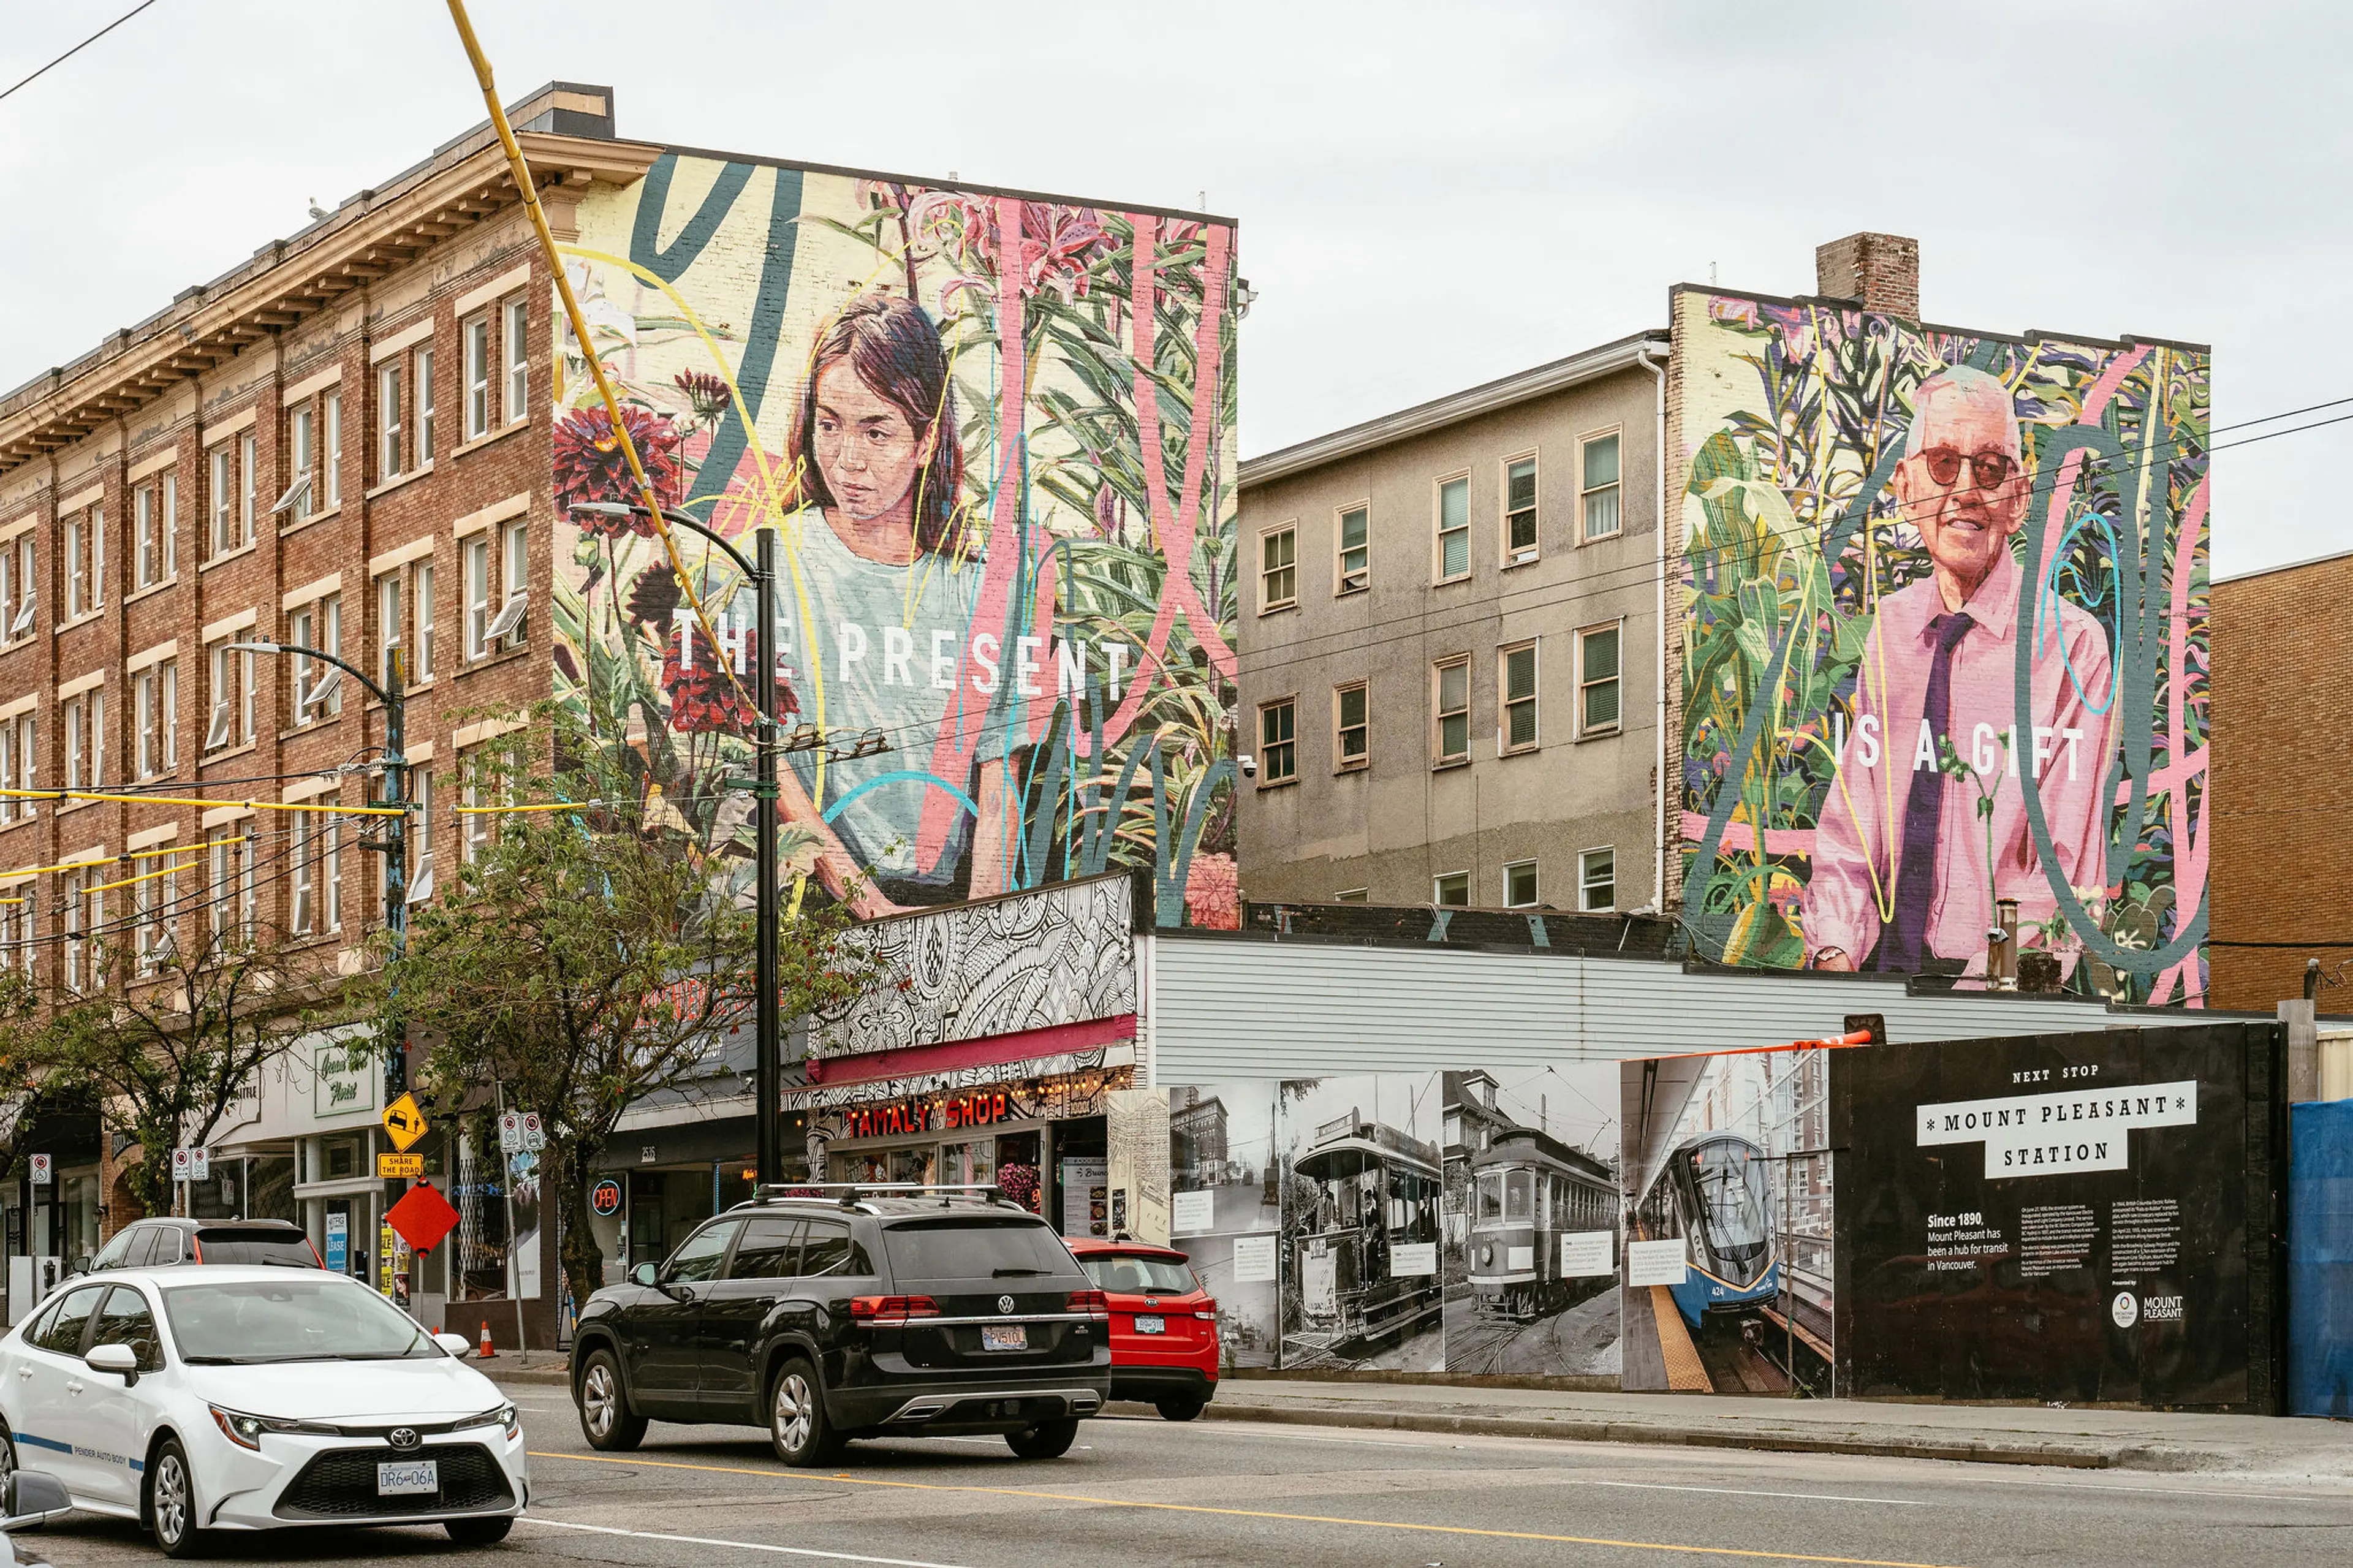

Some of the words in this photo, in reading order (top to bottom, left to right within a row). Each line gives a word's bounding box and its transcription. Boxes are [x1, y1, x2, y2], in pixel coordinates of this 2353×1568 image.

[839, 623, 1129, 700] PRESENT
[1835, 712, 1880, 768] IS
[1913, 718, 1938, 773] A
[1972, 722, 2084, 781] GIFT
[2013, 1069, 2050, 1083] NEXT
[2063, 1065, 2099, 1078] STOP
[847, 1103, 928, 1138] TAMALY
[946, 1094, 1006, 1128] SHOP
[1944, 1109, 2026, 1132] MOUNT
[2041, 1096, 2167, 1123] PLEASANT
[2004, 1142, 2108, 1167] STATION
[594, 1187, 618, 1208] OPEN
[1927, 1214, 1956, 1228] Since
[1958, 1212, 1984, 1226] 1890,
[1928, 1232, 1953, 1243] Mount
[1954, 1230, 1985, 1241] Pleasant
[1987, 1228, 2001, 1239] has
[327, 1241, 344, 1252] LEASE
[1928, 1246, 1947, 1257] been
[1948, 1247, 1953, 1256] a
[1954, 1244, 1969, 1256] hub
[1970, 1243, 1982, 1254] for
[1983, 1242, 2009, 1253] transit
[1928, 1260, 1935, 1271] in
[1936, 1260, 1977, 1271] Vancouver.
[1711, 1286, 1724, 1297] 424
[2144, 1295, 2183, 1309] MOUNT
[2144, 1308, 2183, 1319] PLEASANT
[74, 1446, 96, 1459] PENDER
[97, 1451, 112, 1462] AUTO
[112, 1454, 126, 1465] BODY
